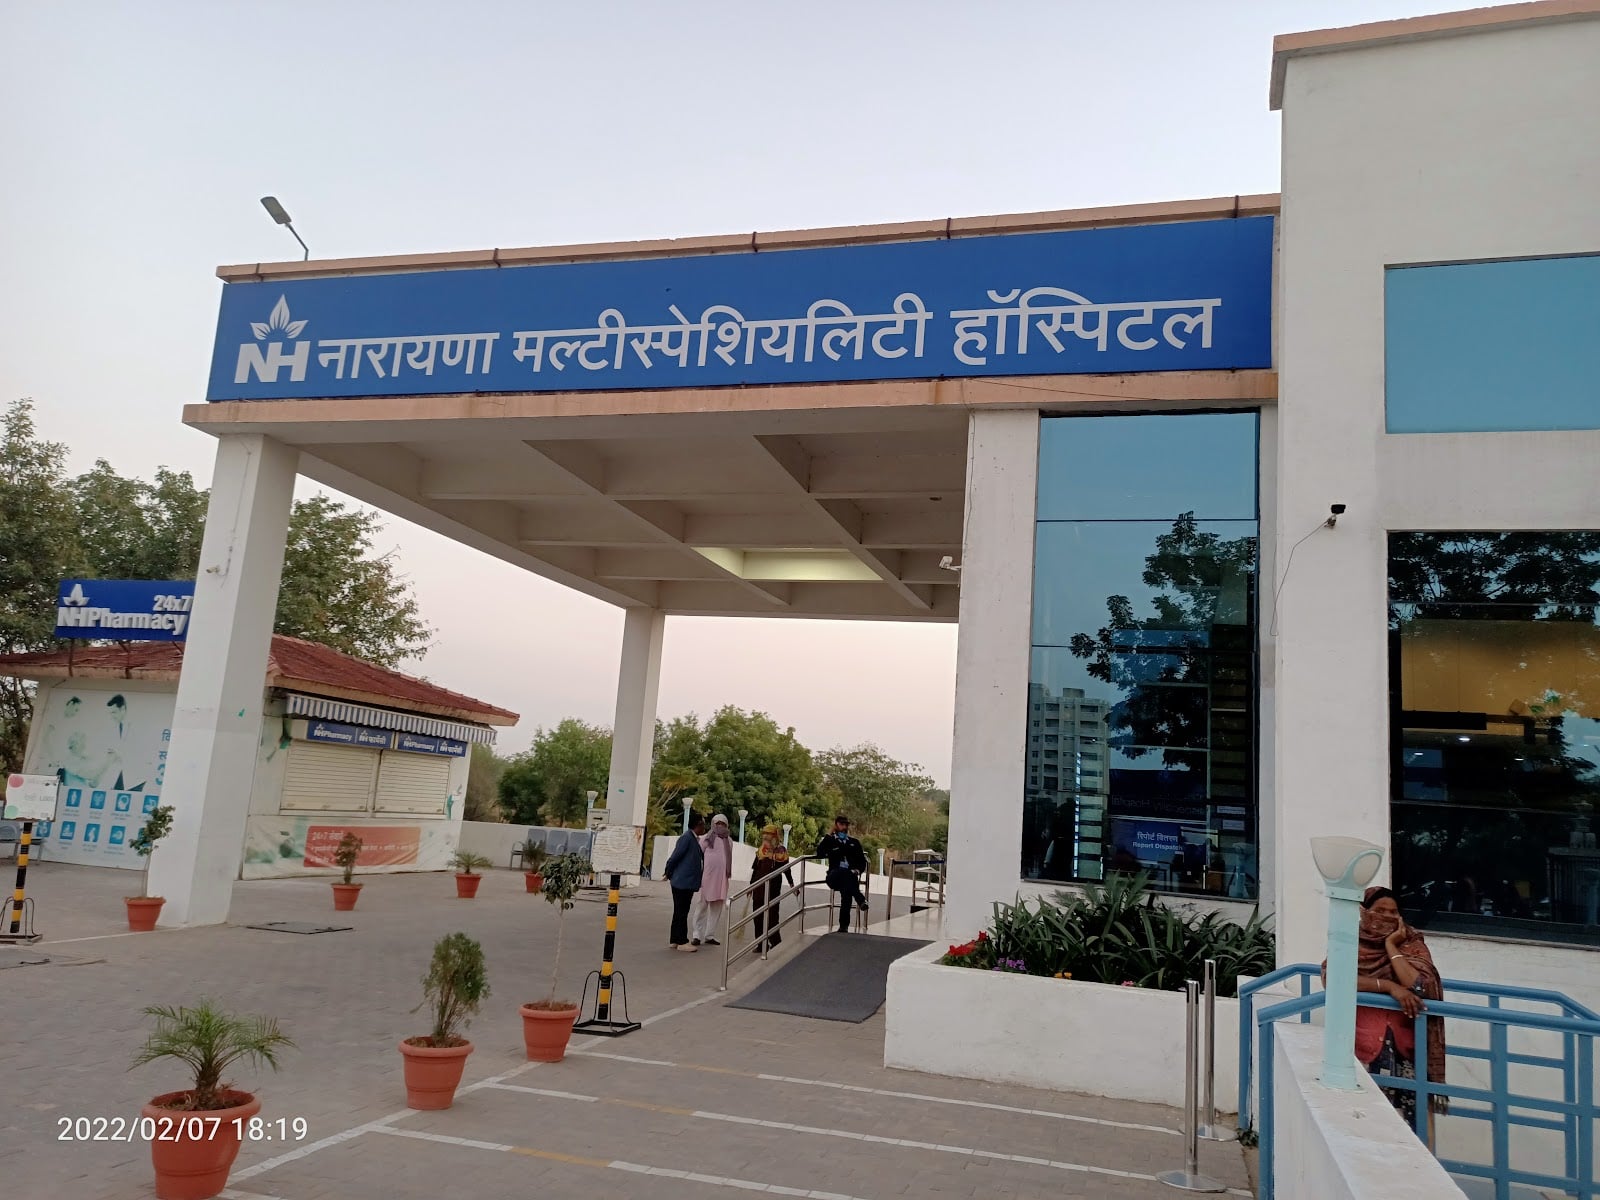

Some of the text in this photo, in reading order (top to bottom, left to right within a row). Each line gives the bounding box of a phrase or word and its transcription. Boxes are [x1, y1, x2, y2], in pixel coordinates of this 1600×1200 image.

[318, 286, 1222, 379] नारायणा मल्टीस्पेशियलिटी हॉस्पिटल
[235, 341, 310, 383] NH
[1132, 842, 1183, 851] Report Dispatch
